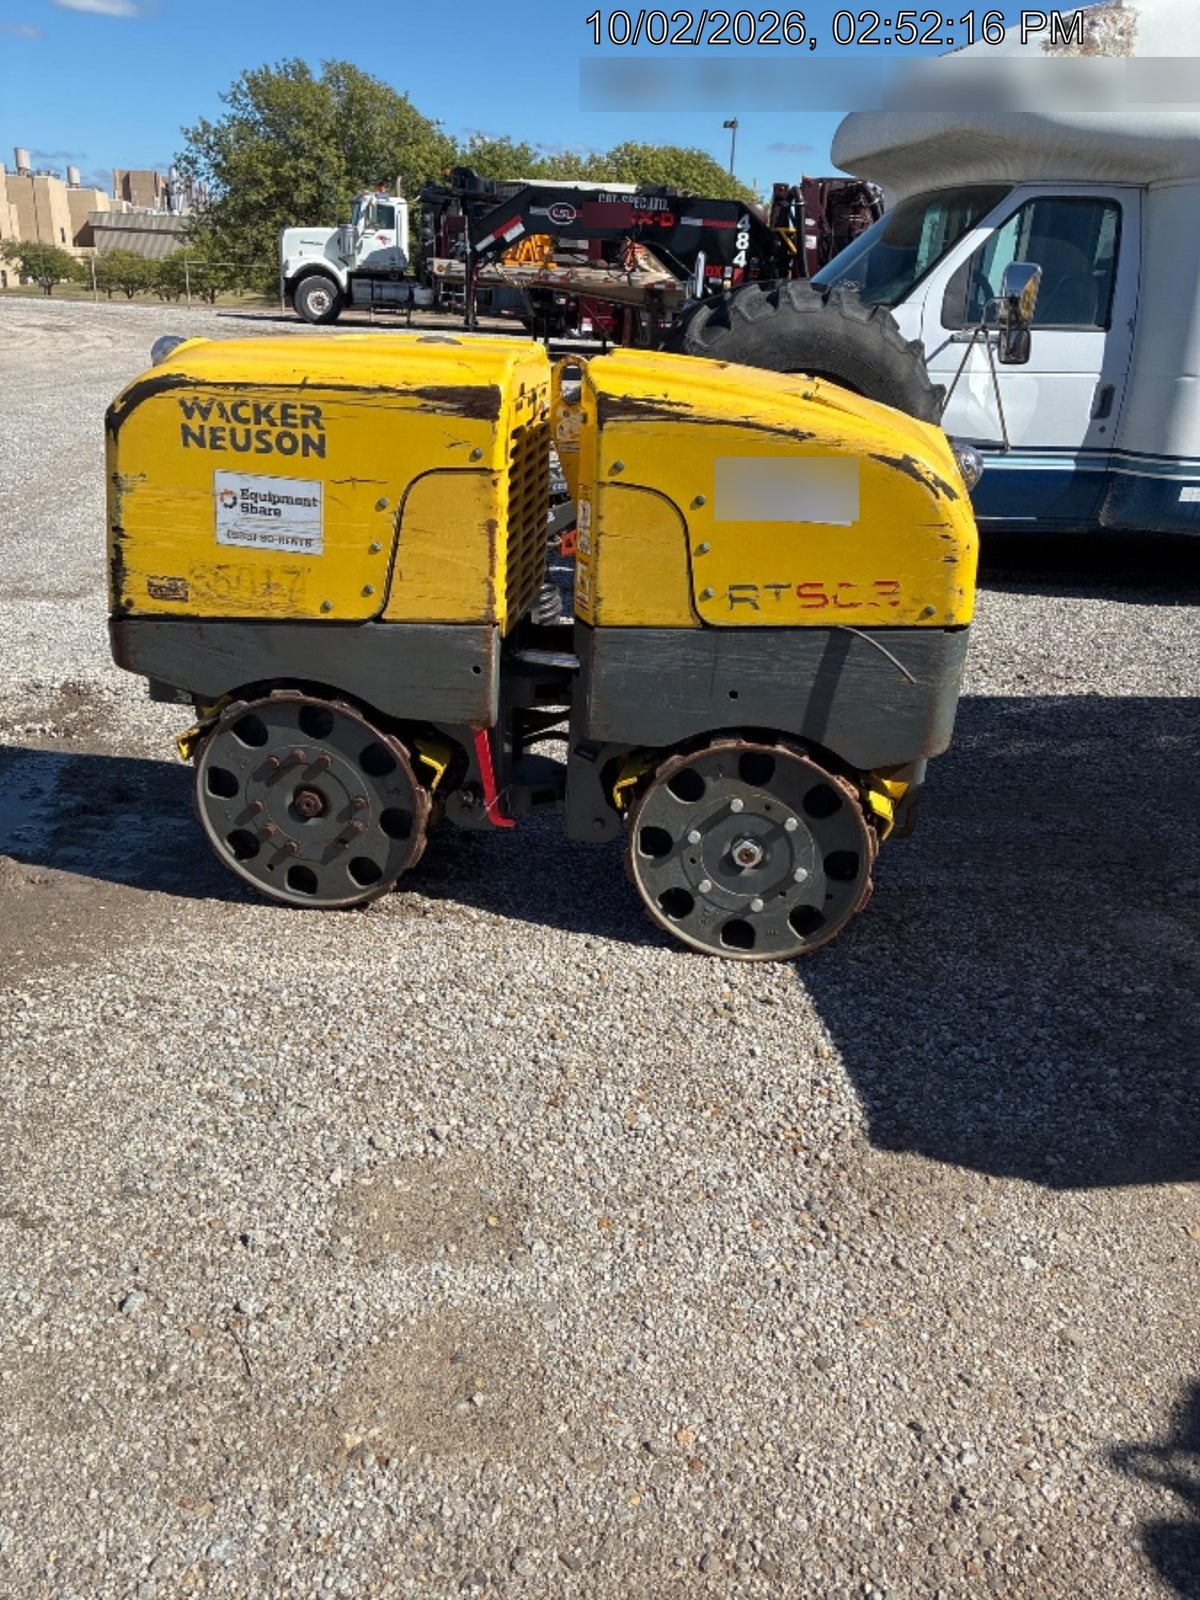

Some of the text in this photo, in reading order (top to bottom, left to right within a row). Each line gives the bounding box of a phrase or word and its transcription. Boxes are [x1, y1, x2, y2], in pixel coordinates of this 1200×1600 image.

[180, 423, 326, 459] NEUSON
[239, 488, 318, 507] Equipment
[240, 502, 282, 517] Share
